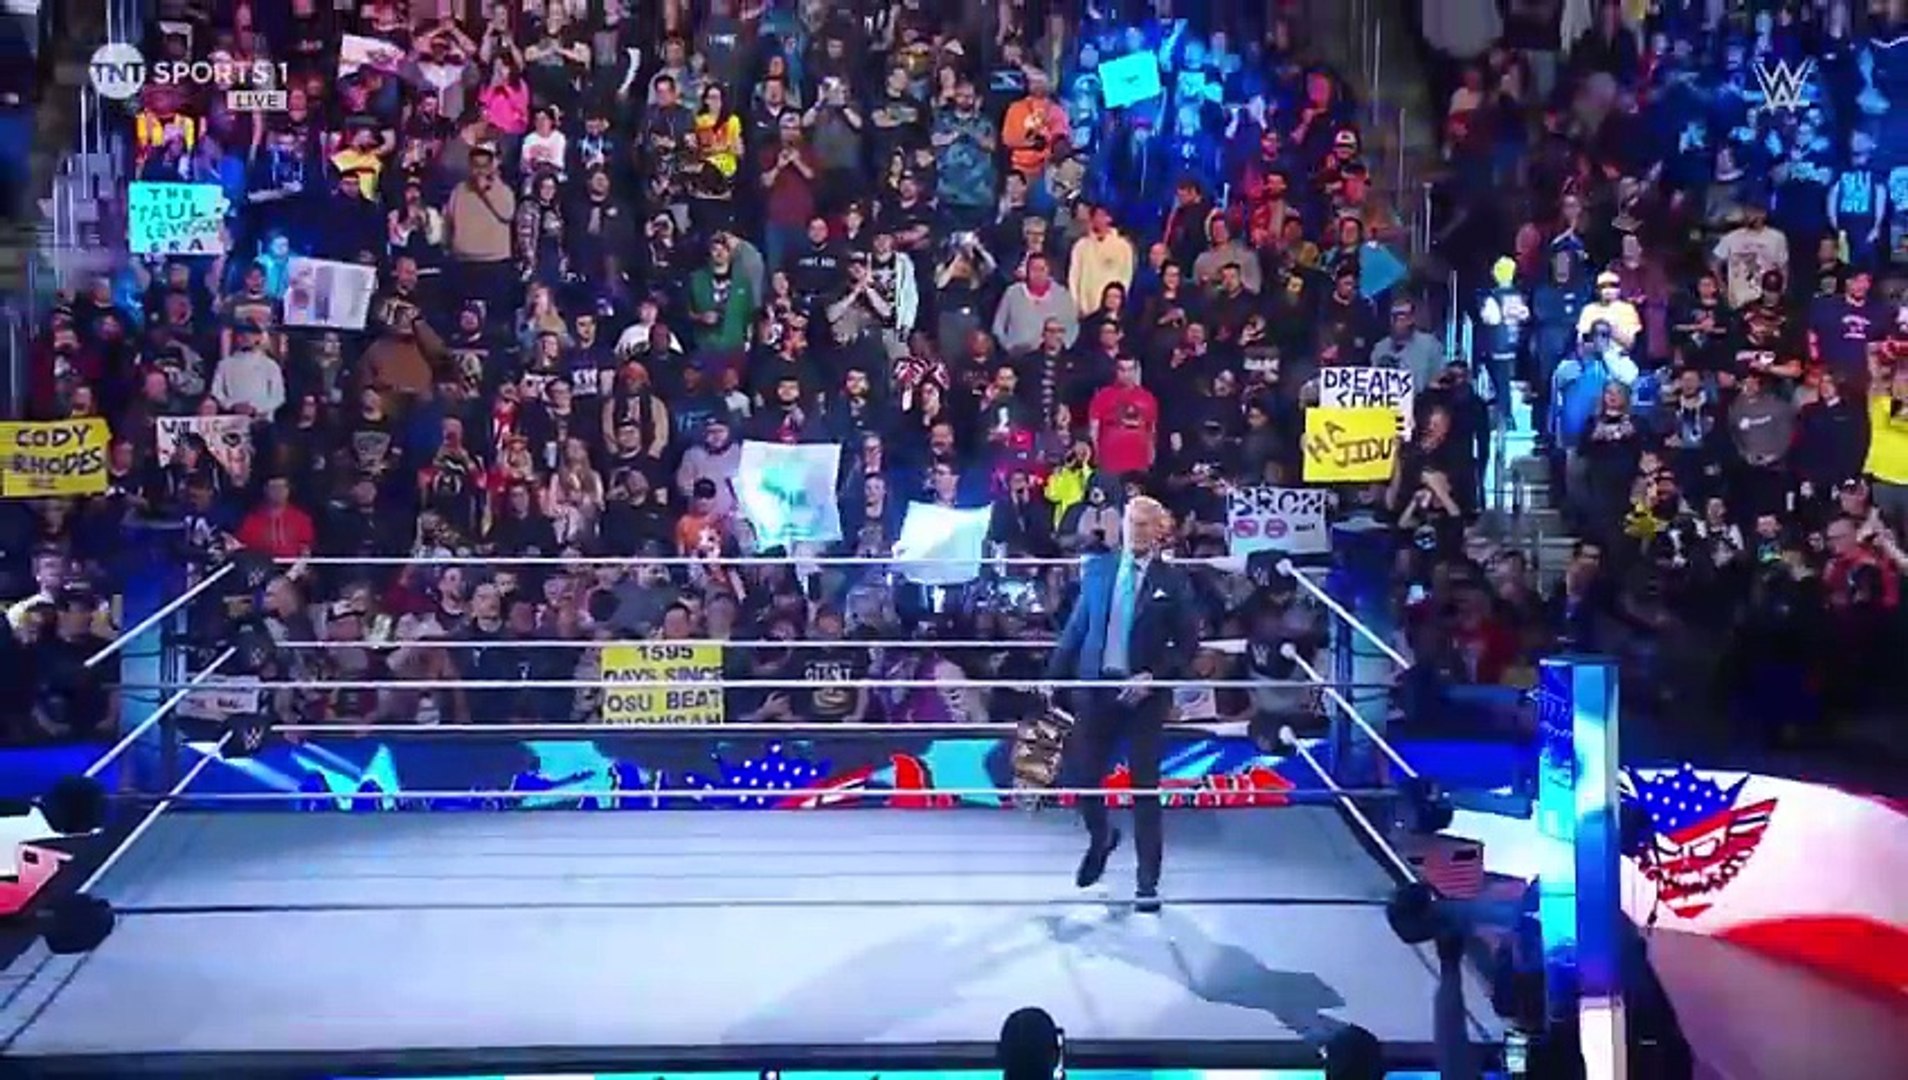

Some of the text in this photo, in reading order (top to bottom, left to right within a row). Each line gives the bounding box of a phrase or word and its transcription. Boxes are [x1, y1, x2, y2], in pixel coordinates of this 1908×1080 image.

[147, 188, 193, 200] THE
[1325, 368, 1412, 398] DREAMS
[17, 424, 93, 447] CODY
[13, 447, 102, 475] RHODES
[638, 645, 694, 661] 1595
[603, 665, 724, 680] DAYS SINCE
[606, 689, 719, 712] OSU BEAT
